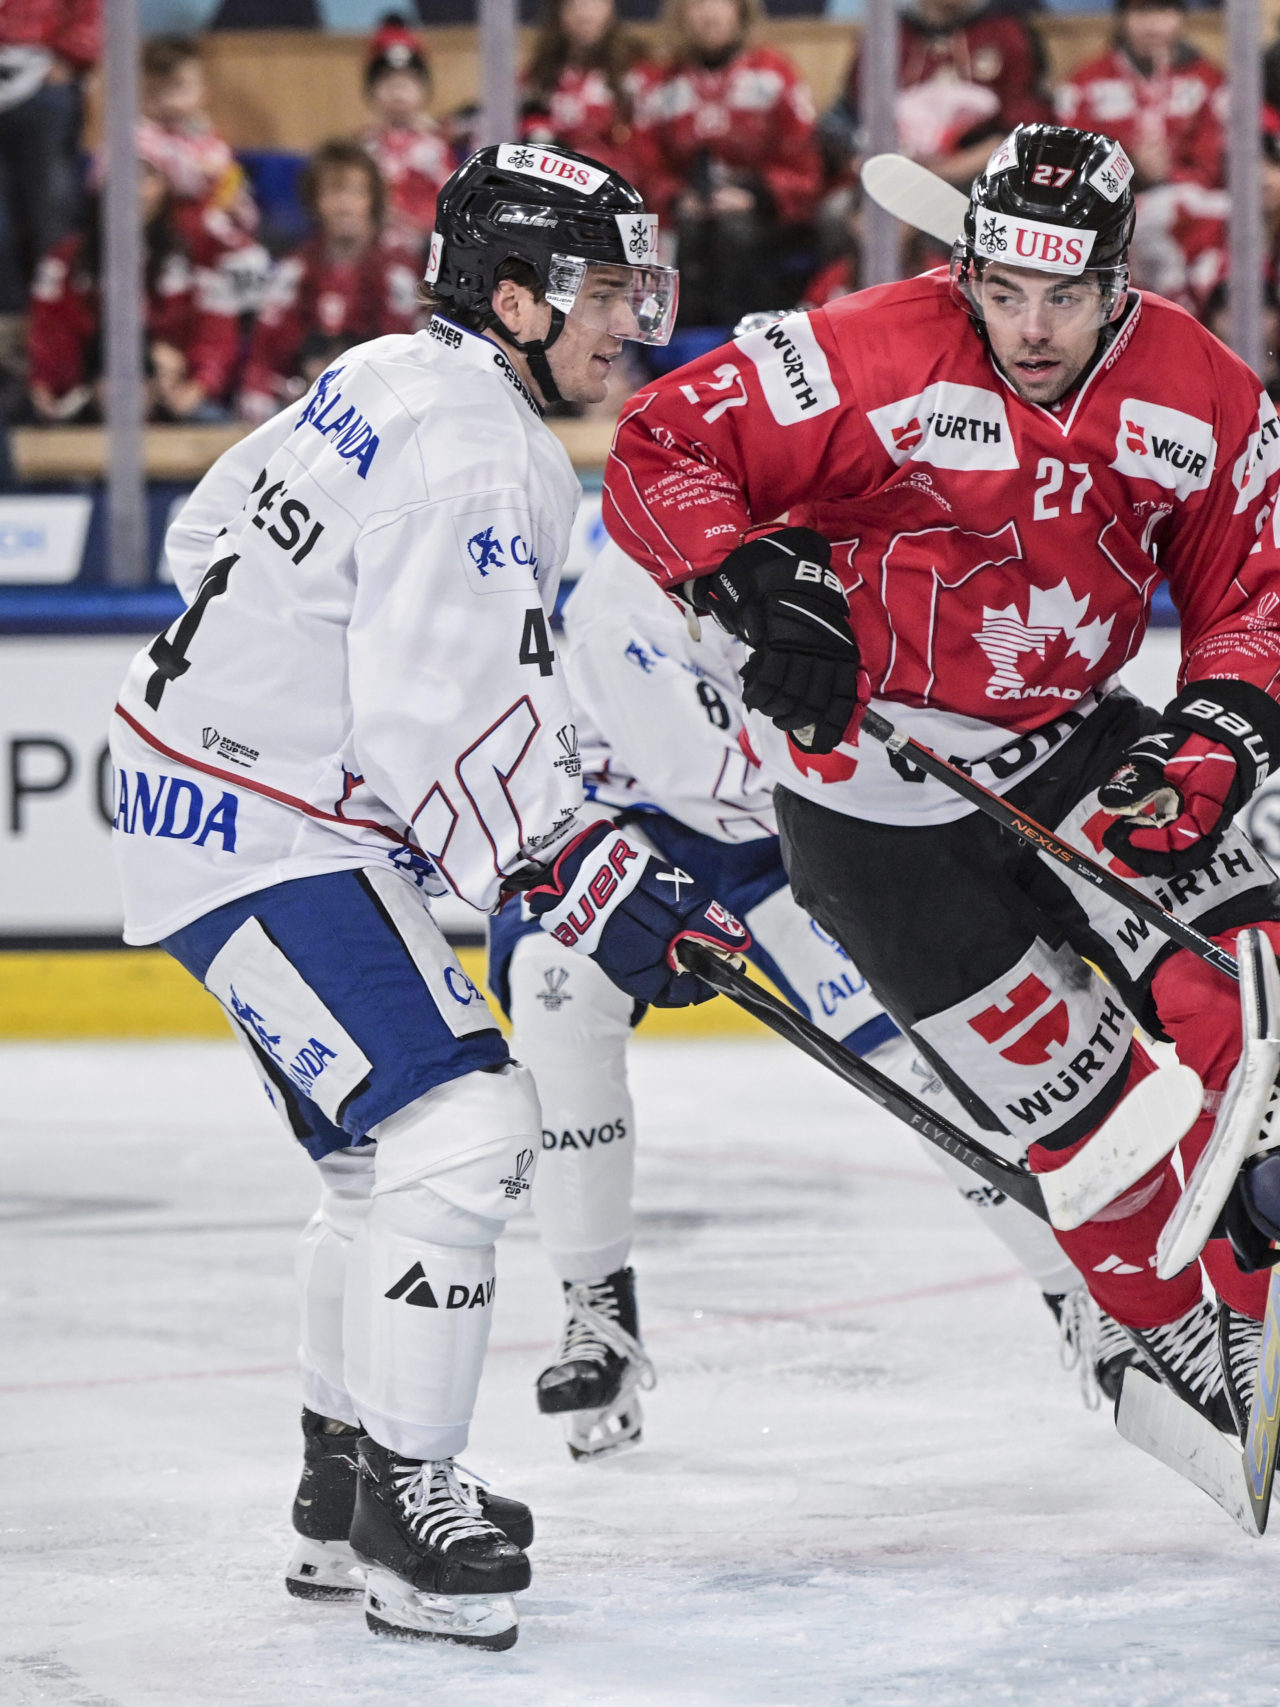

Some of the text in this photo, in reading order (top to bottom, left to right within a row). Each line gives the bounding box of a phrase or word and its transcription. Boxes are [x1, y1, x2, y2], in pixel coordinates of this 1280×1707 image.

[539, 155, 591, 187] UBS
[1031, 164, 1076, 188] 27
[1111, 152, 1131, 181] UBS
[1015, 227, 1084, 266] UBS
[763, 324, 819, 412] WÜRTH
[678, 363, 749, 425] 27
[928, 412, 1002, 443] ÜRTH
[1033, 457, 1094, 521] 27
[704, 523, 737, 539] 2025
[720, 573, 740, 603] CANADA
[519, 608, 555, 677] 4
[220, 742, 239, 754] CUP
[222, 737, 260, 757] SPENGLER
[1104, 784, 1133, 795] ANADA
[114, 768, 239, 854] ANDA
[1010, 819, 1074, 863] NEXUS
[553, 838, 640, 948] AUER
[288, 1037, 339, 1098] ANDA
[1006, 996, 1127, 1125] WÜRTH
[541, 1118, 627, 1151] DAVOS
[910, 1113, 983, 1168] FLYLITE
[499, 1178, 531, 1190] SPENGLER
[505, 1186, 521, 1196] CUP
[446, 1276, 496, 1310] DAV
